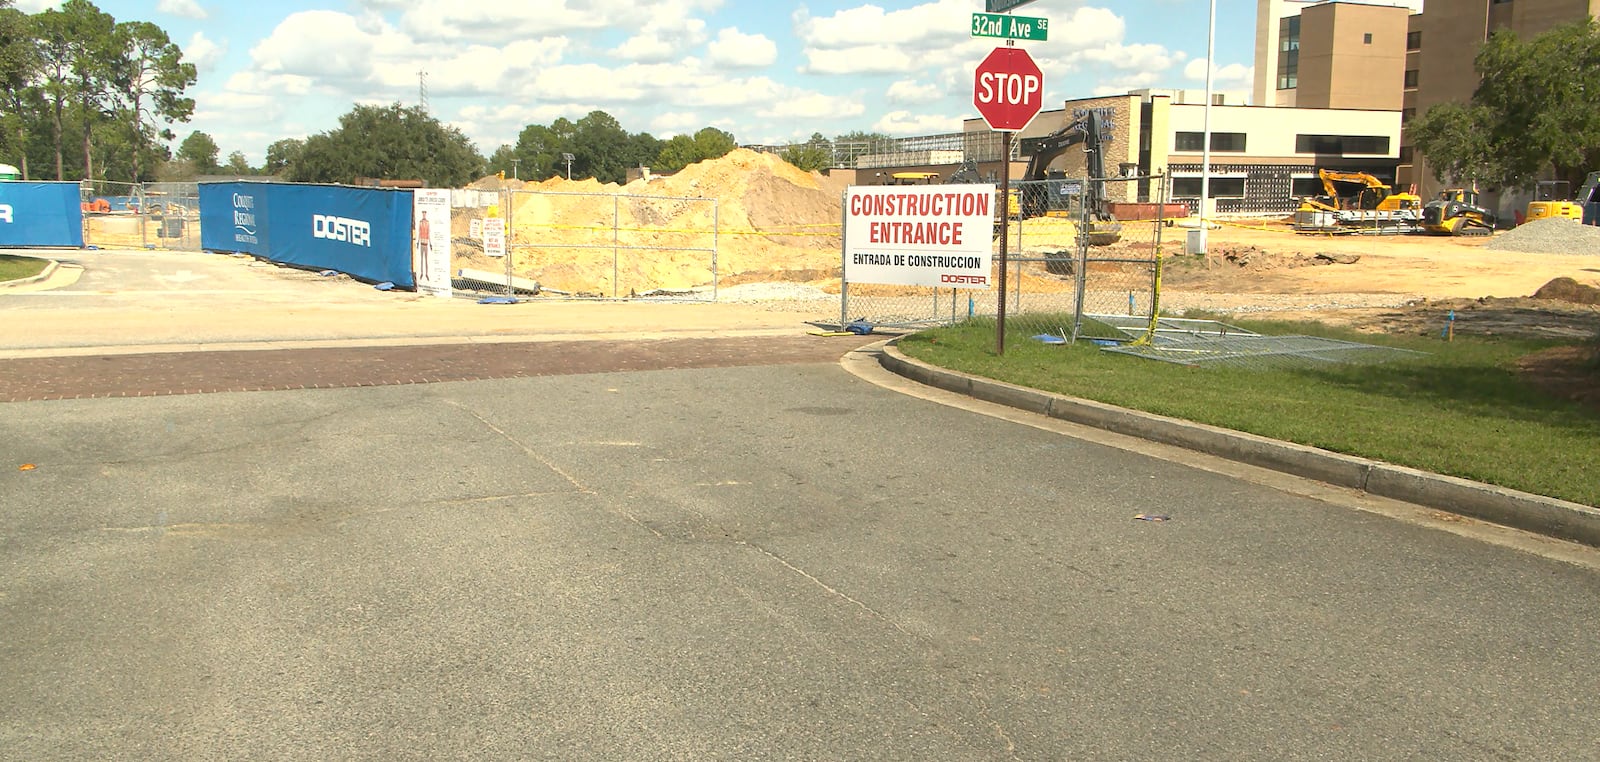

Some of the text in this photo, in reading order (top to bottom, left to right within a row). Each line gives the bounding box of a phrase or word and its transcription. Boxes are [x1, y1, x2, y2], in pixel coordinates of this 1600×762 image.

[972, 15, 1048, 38] 32nd Ave SE
[978, 72, 1039, 105] STOP
[851, 193, 989, 216] CONSTRUCTION
[313, 214, 371, 247] DOSTER
[870, 222, 963, 245] ENTRANCE
[853, 253, 981, 269] ENTRADA DE CONSTRUCCION
[941, 274, 986, 285] DOSTER
